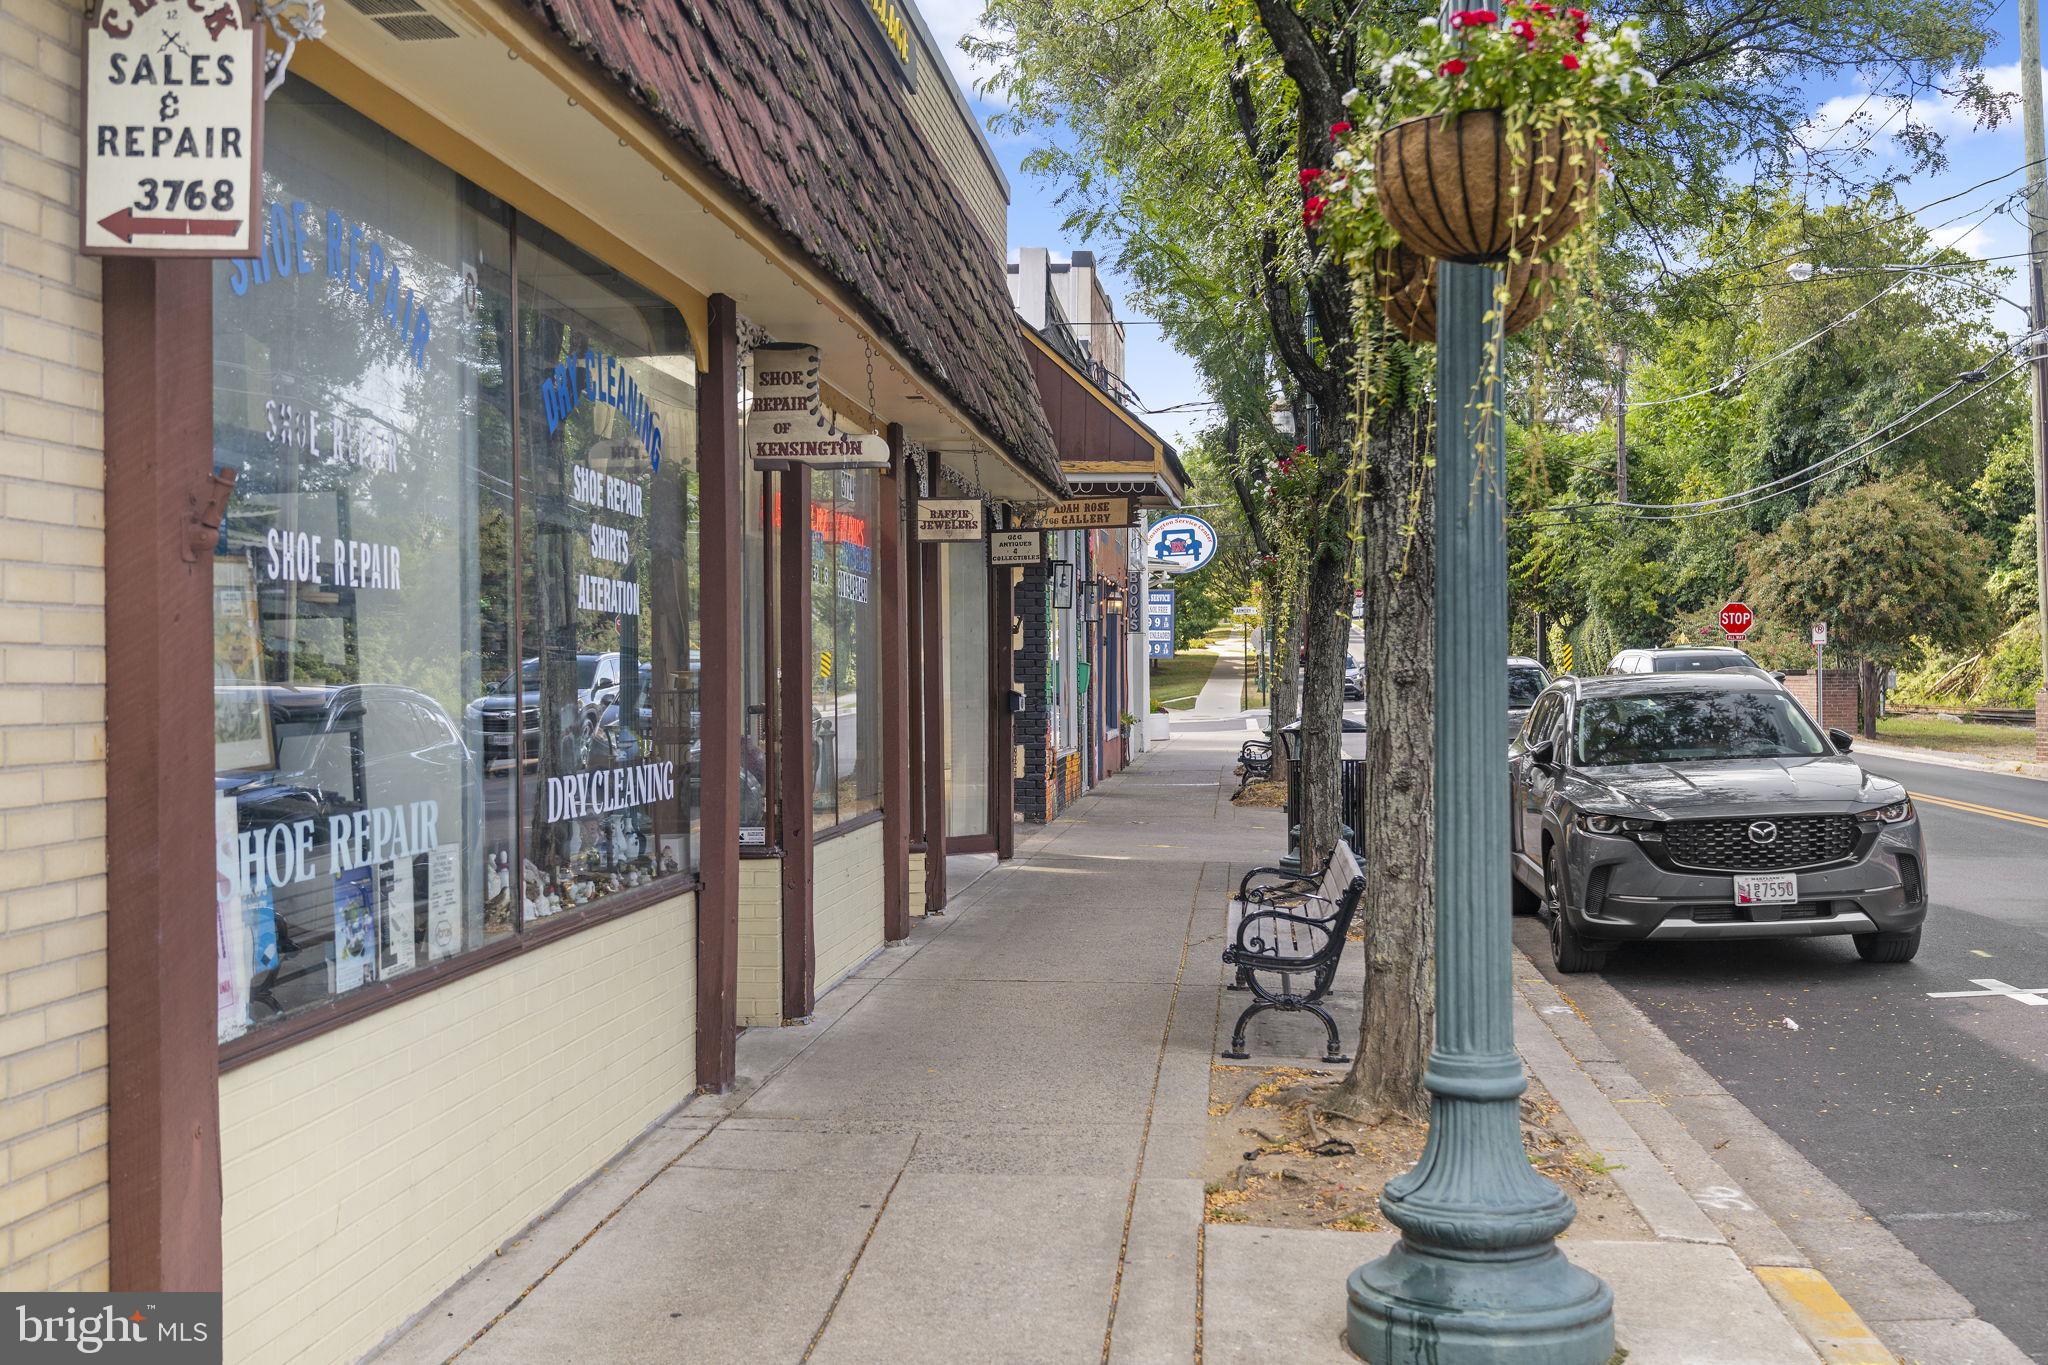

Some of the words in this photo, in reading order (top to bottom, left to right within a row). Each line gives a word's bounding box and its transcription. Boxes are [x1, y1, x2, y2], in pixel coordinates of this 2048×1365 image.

[108, 54, 235, 86] SALES
[159, 91, 180, 121] &
[97, 125, 242, 158] REPAIR
[133, 178, 235, 211] 3768
[326, 209, 430, 369] REPAIR
[759, 371, 804, 386] SHOE
[541, 350, 579, 435] DRY
[584, 346, 662, 475] CLEANING
[752, 396, 808, 412] REPAIR
[265, 400, 320, 458] SHOE
[773, 423, 791, 434] OF
[756, 440, 863, 457] KENSINGTON
[573, 463, 604, 508] SHOE
[606, 474, 643, 519] REPAIR
[1084, 501, 1110, 513] ROSE
[919, 520, 978, 530] JEWELERS
[1061, 514, 1111, 525] GALLERY
[1174, 518, 1198, 528] Service
[1198, 525, 1213, 543] Center
[267, 527, 322, 584] SHOE
[334, 538, 401, 590] REPAIR
[591, 523, 629, 565] SHIRTS
[992, 554, 1040, 562] COLLECTIBLES
[578, 574, 640, 616] ALTERATION
[1129, 573, 1139, 631] BOOKS
[1721, 612, 1751, 625] STOP
[217, 819, 315, 903] SHOE
[328, 800, 439, 875] REPAIR
